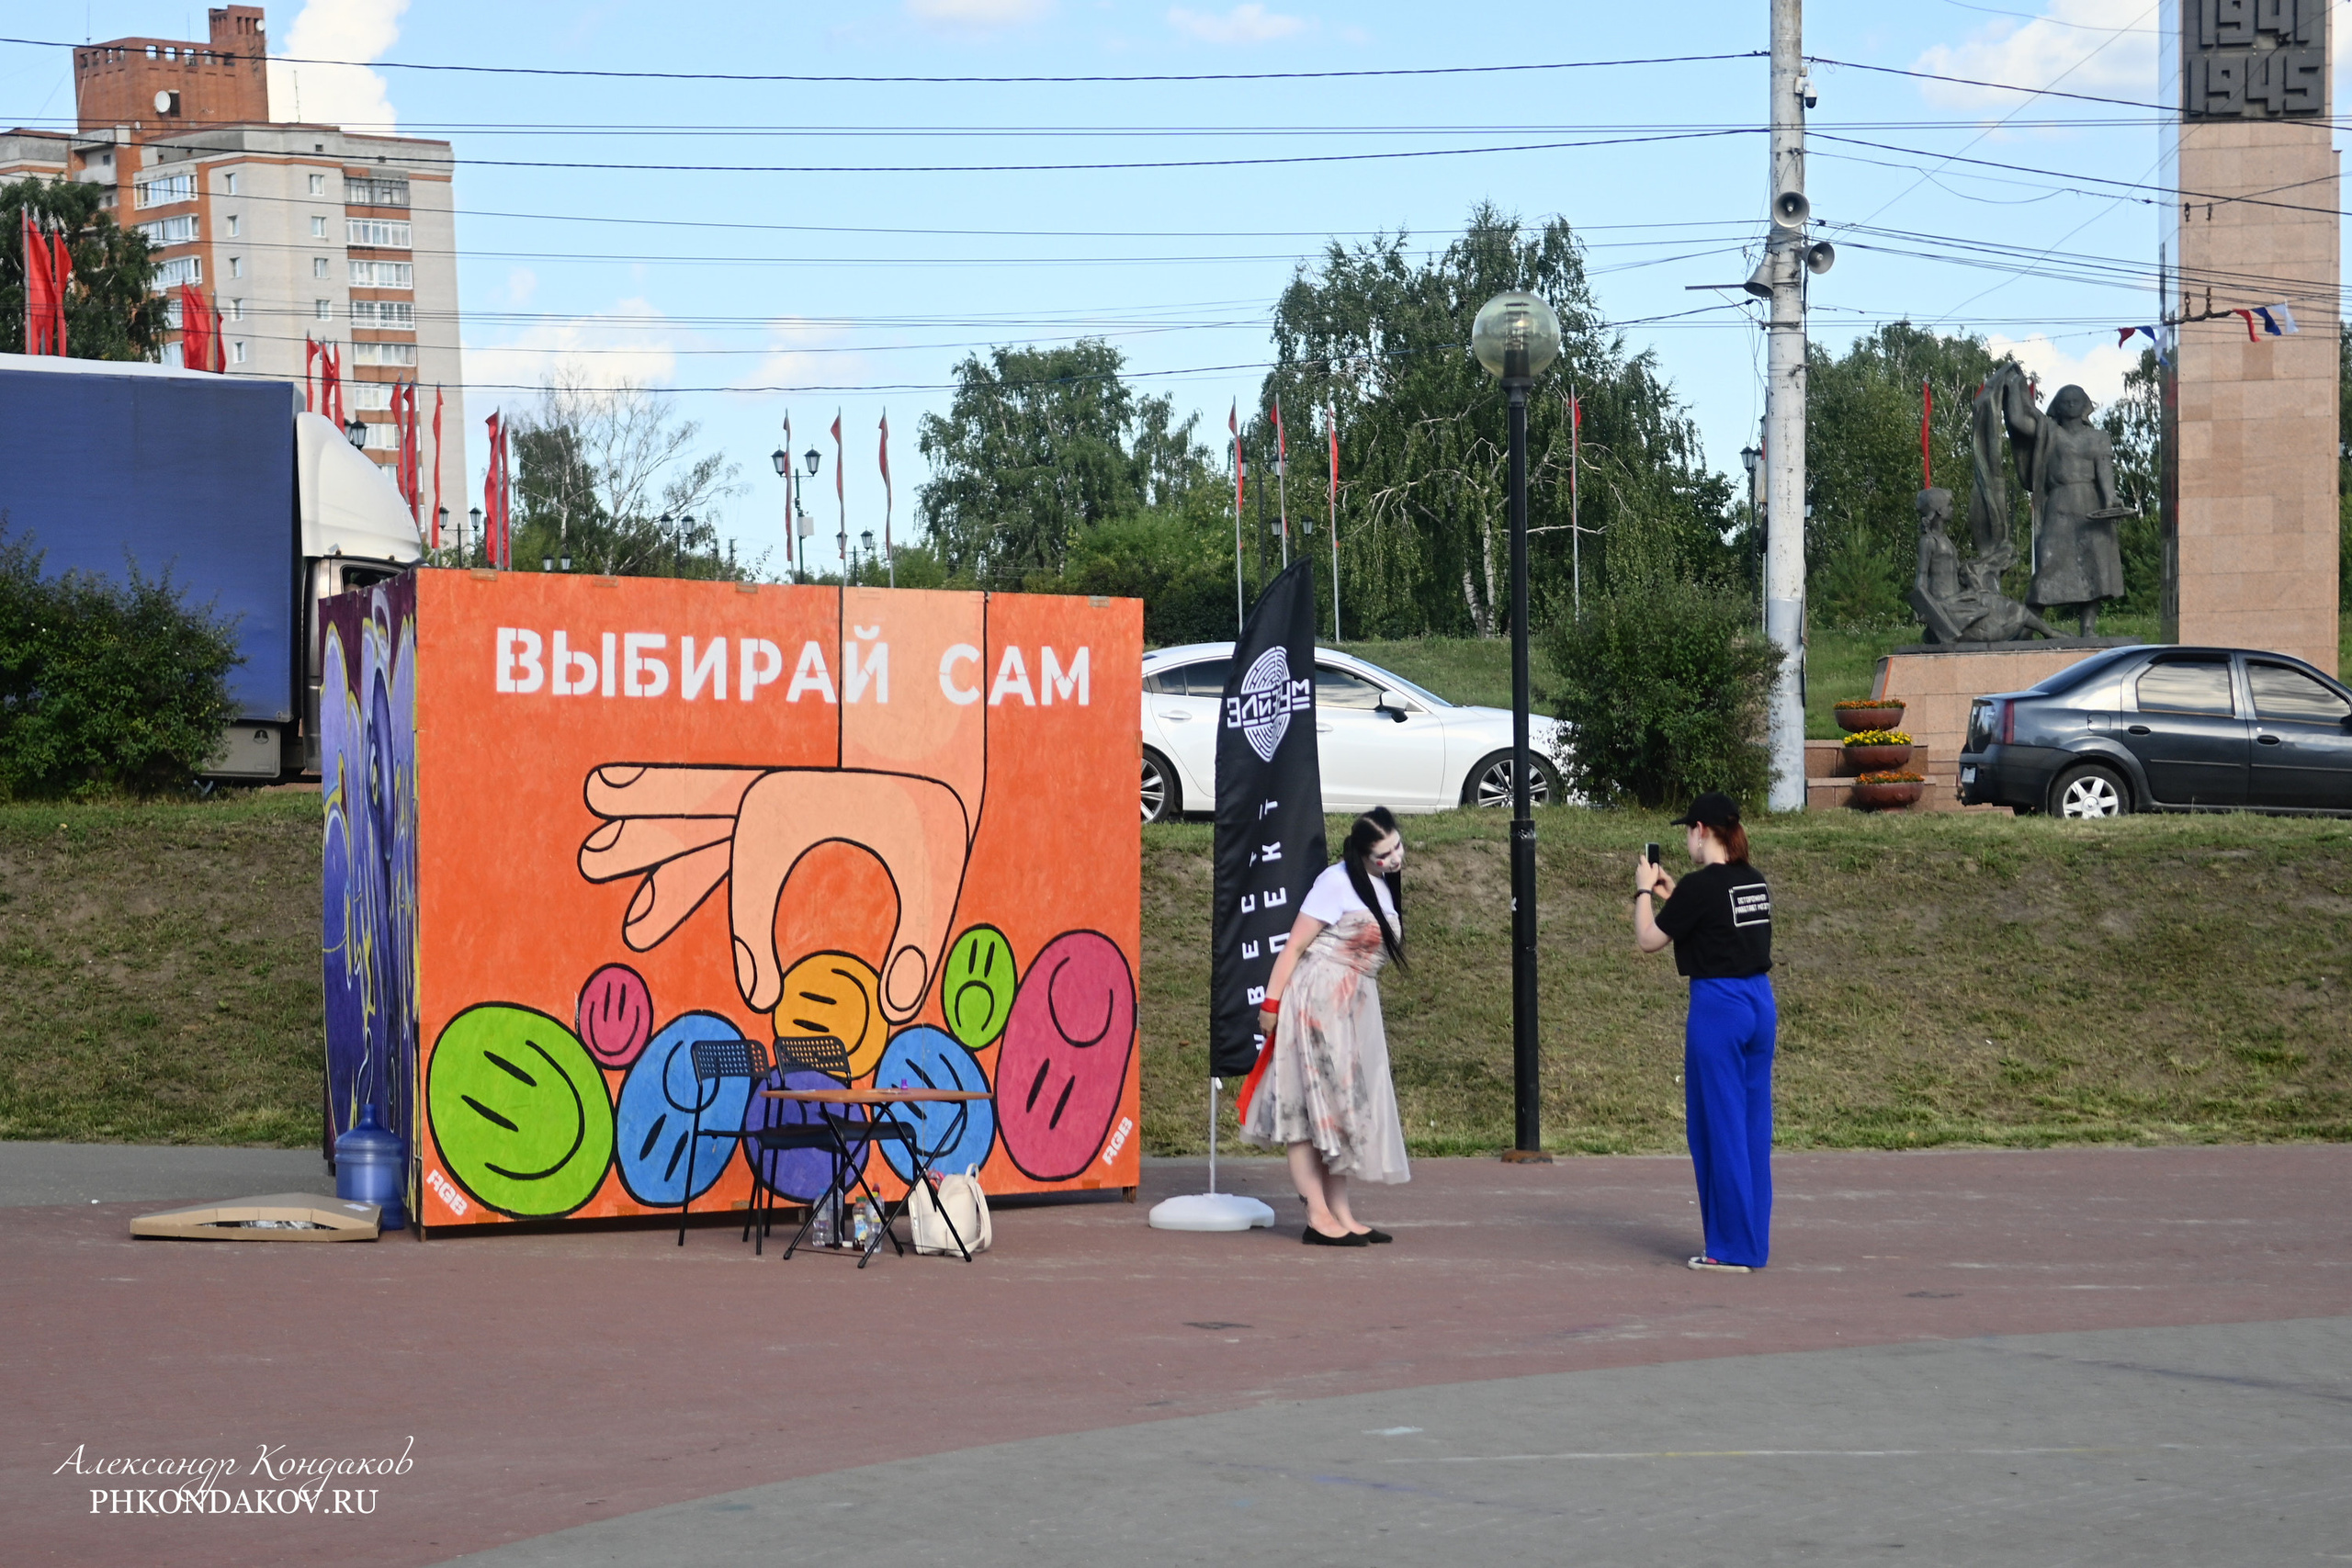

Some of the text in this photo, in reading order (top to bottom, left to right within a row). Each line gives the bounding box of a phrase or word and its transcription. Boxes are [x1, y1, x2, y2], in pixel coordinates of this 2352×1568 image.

[2199, 0, 2312, 48] 1941
[2189, 54, 2321, 117] 1945
[496, 625, 1090, 706] ВЫБИРАЙ САМ
[1102, 1116, 1133, 1166] RGB
[425, 1168, 468, 1216] RGB
